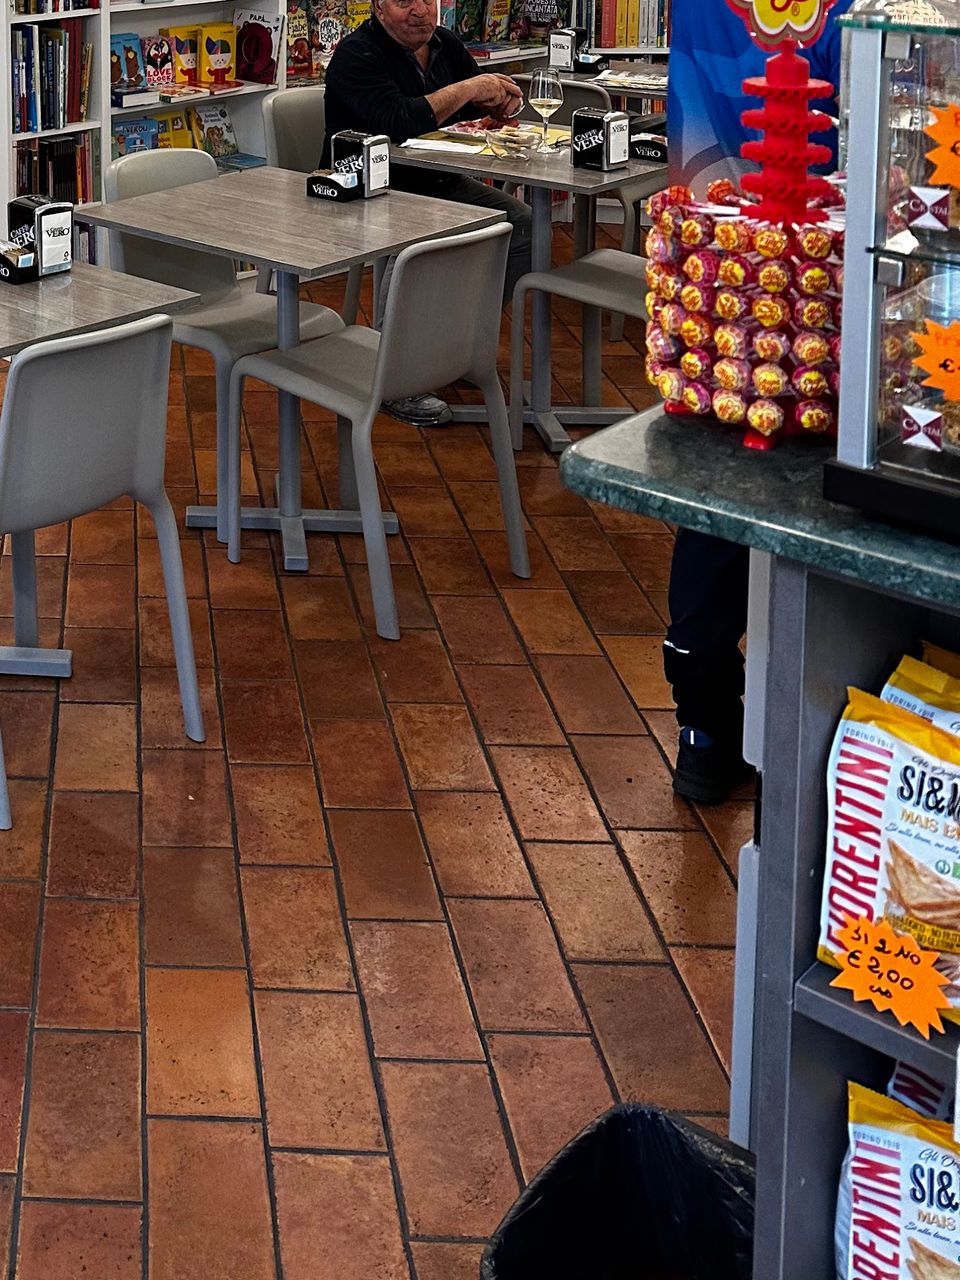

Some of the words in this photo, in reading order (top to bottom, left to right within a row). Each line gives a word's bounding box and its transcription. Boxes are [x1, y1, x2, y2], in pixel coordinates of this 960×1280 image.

[525, 4, 558, 14] INCANTATA
[321, 21, 339, 32] FAVOLE
[321, 33, 340, 43] ESOPO
[147, 69, 171, 77] LOVE
[575, 129, 598, 141] CAFFÈ
[636, 147, 661, 157] VERO
[335, 155, 358, 167] CAFFÈ
[312, 185, 338, 197] VERO
[10, 224, 29, 239] CAFFÈ
[46, 227, 70, 238] VERO
[890, 694, 917, 710] TORINO
[846, 727, 875, 743] TORINO
[897, 765, 960, 823] SI&N
[901, 807, 939, 833] MAIS
[895, 946, 921, 966] NO
[848, 950, 863, 968] €
[867, 956, 914, 990] 2,00
[853, 1131, 881, 1145] TORINO
[919, 1149, 938, 1162] Gli
[851, 1140, 901, 1280] RENTINI
[917, 1209, 957, 1231] MAIS
